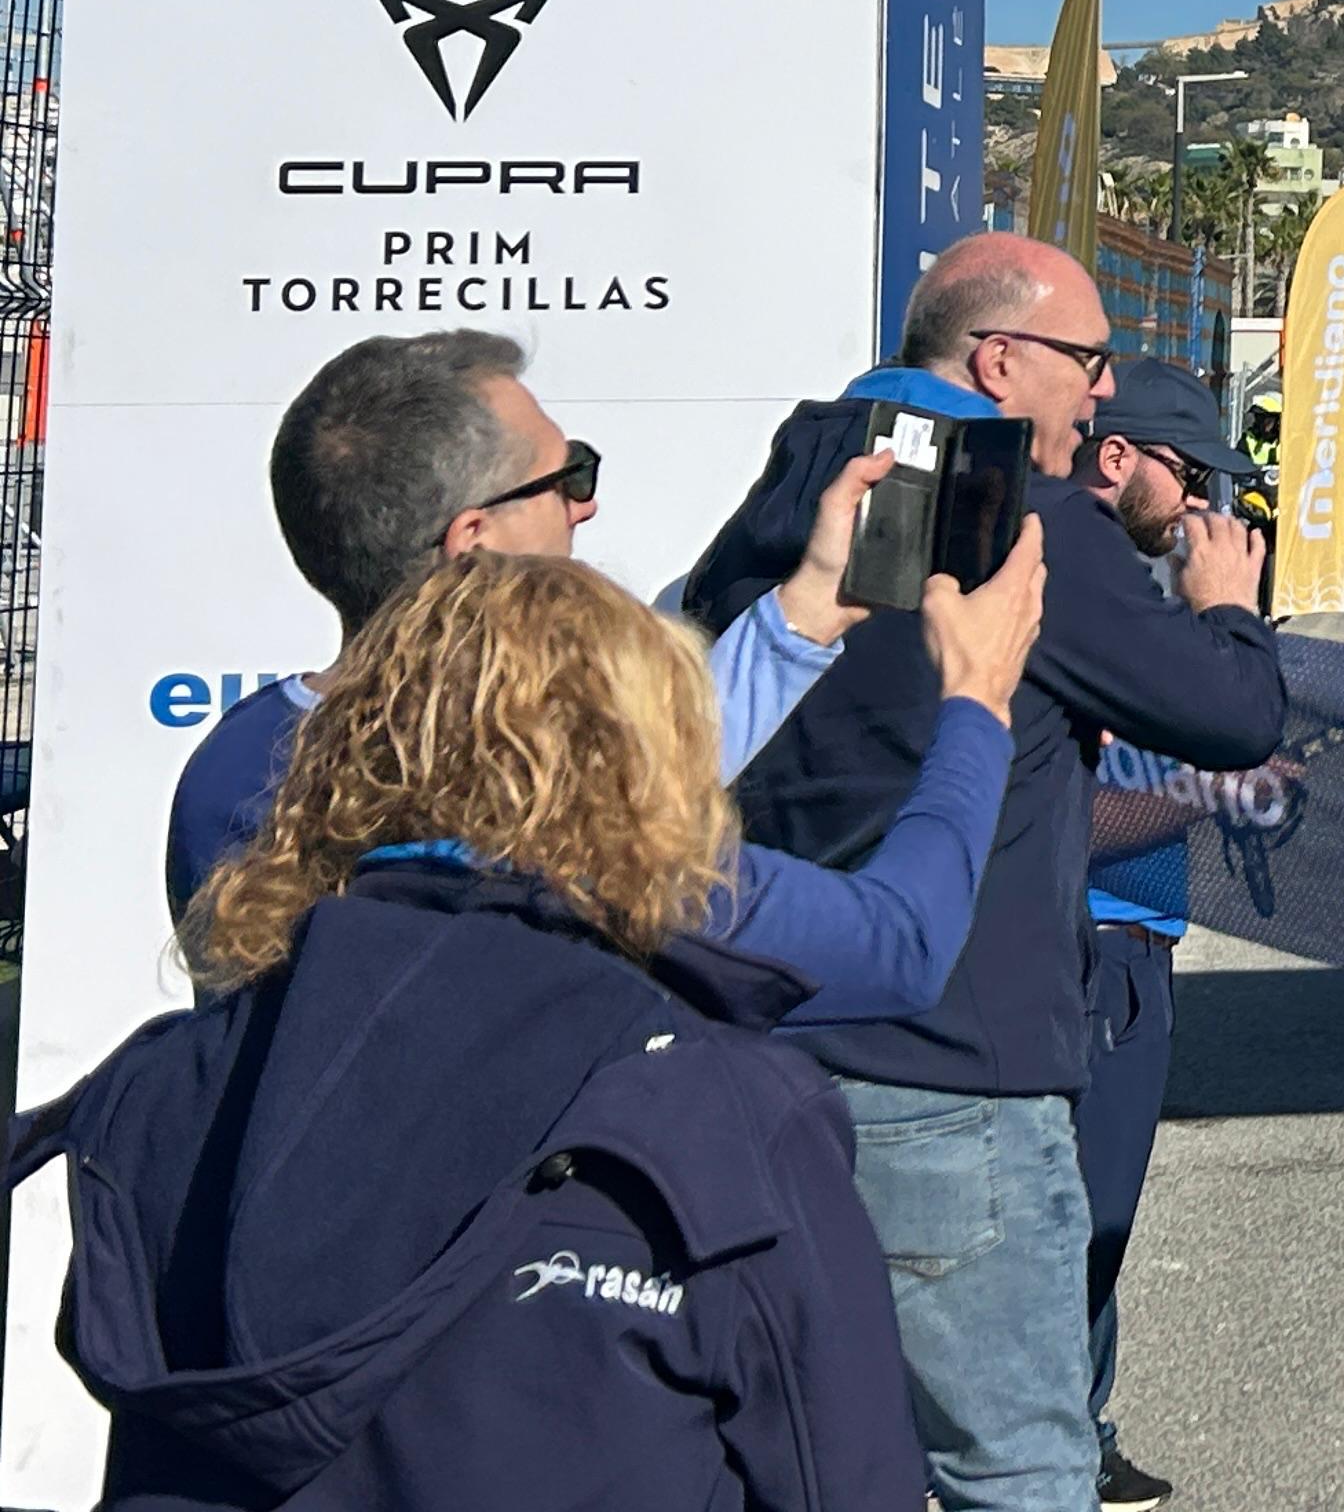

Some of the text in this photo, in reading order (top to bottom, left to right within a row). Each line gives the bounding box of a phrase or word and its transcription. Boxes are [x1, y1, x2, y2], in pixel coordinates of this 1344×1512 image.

[277, 159, 641, 195] CUPRA
[384, 230, 533, 266] PRIM
[243, 275, 672, 312] TORRECILLAS
